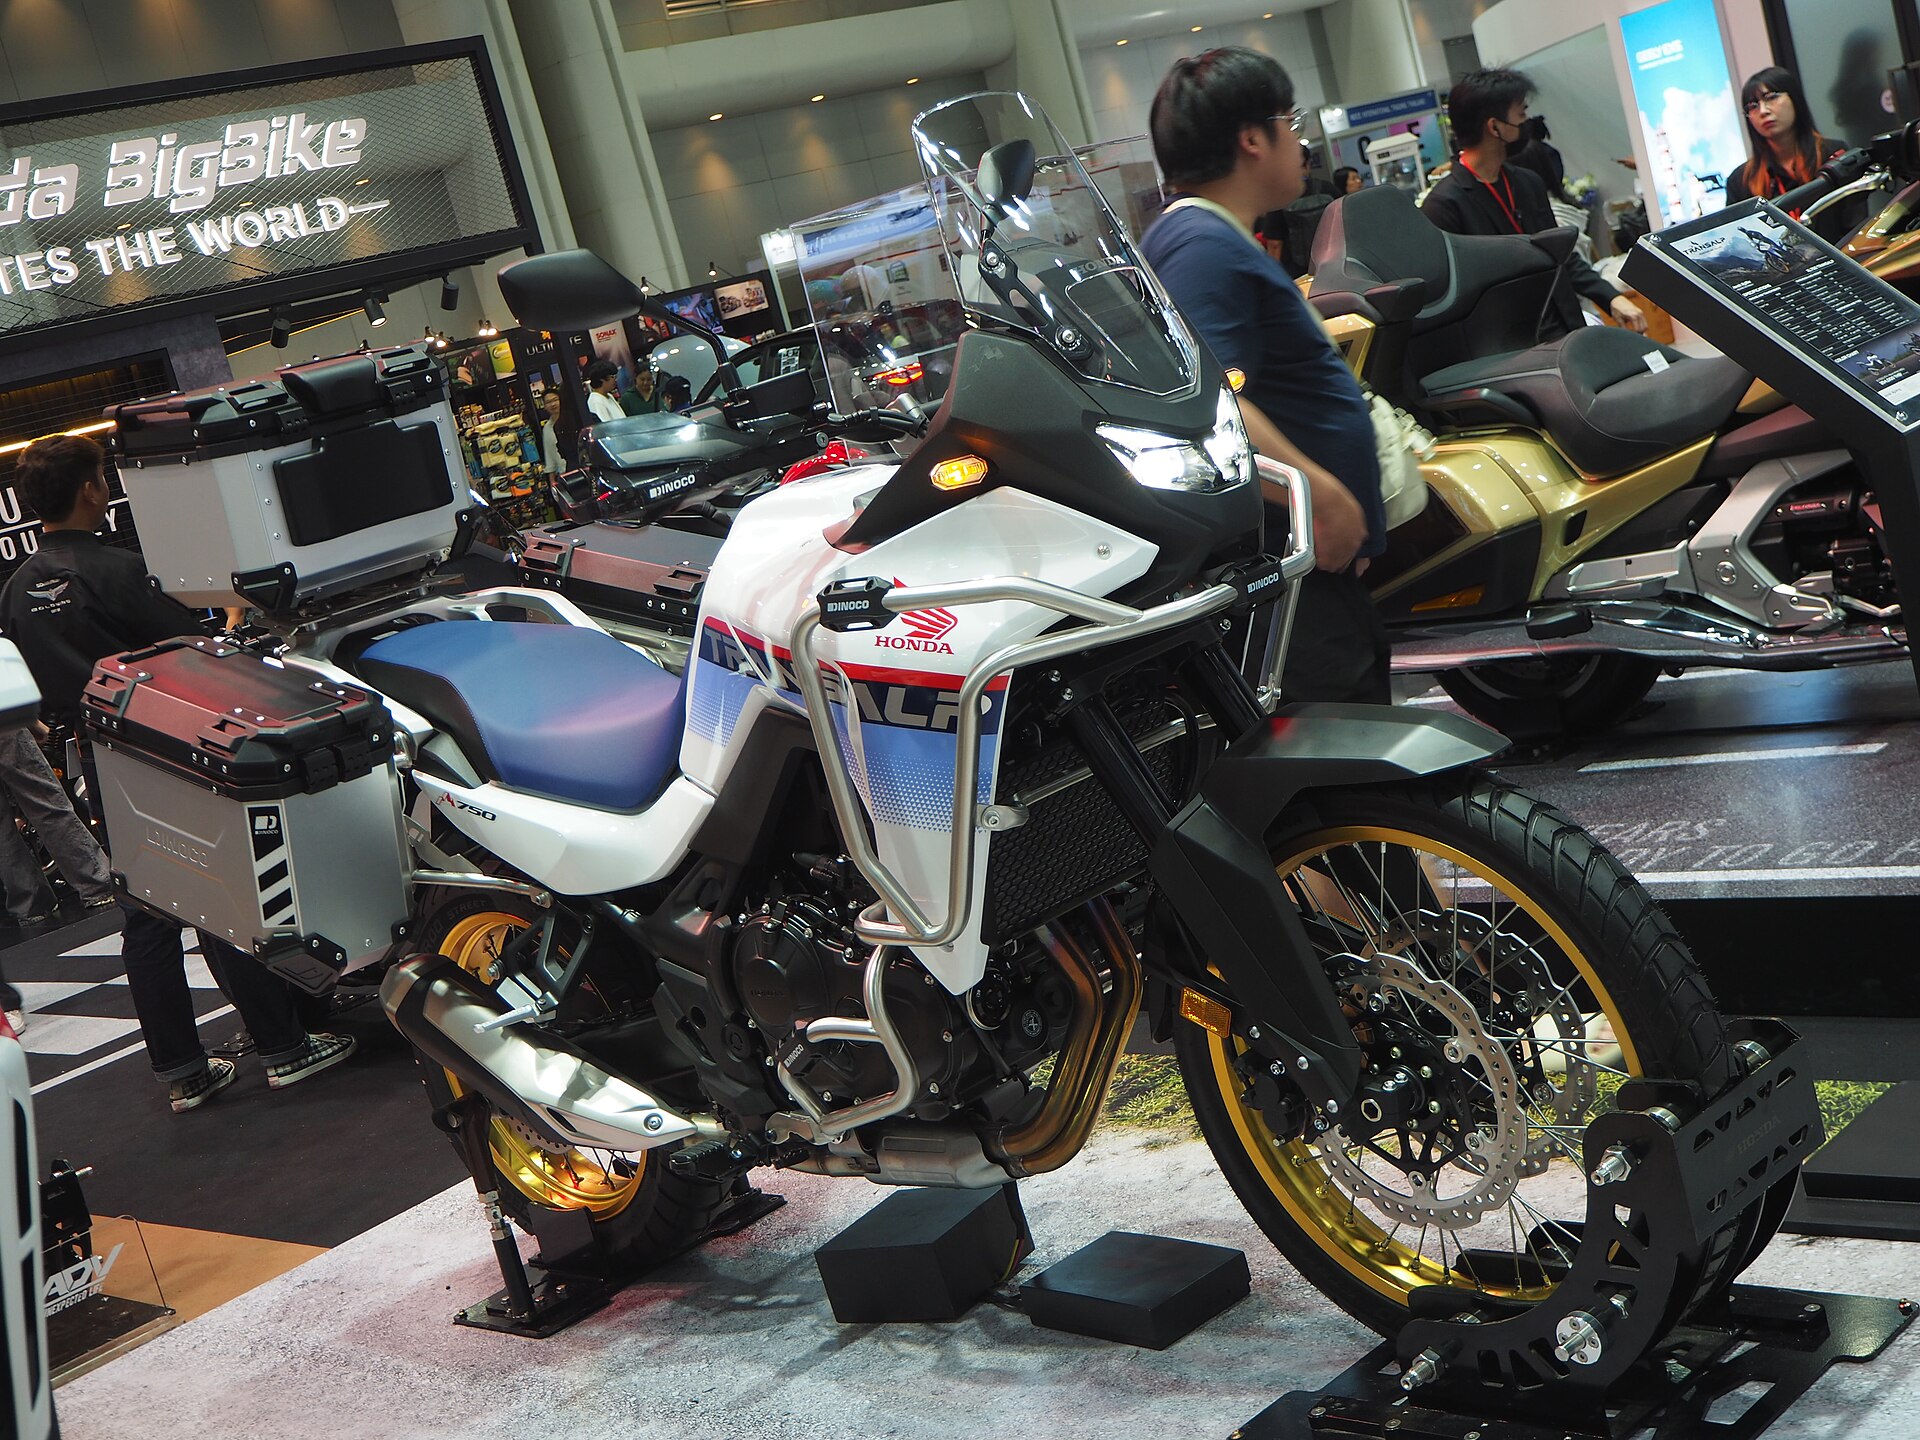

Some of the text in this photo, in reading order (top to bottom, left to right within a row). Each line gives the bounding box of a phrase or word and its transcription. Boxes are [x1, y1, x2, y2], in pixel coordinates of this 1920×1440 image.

[104, 113, 367, 213] BigBike
[86, 227, 182, 276] THE
[186, 197, 349, 257] WORLD
[1683, 237, 1726, 256] TRANSALP
[596, 328, 617, 338] SONAX
[526, 335, 583, 356] ULTITE
[649, 475, 696, 499] DINOCO
[1247, 572, 1279, 594] DINOCO
[827, 599, 870, 612] DINOCO
[874, 635, 955, 655] HONDA
[783, 1043, 805, 1068] DINOCO
[1737, 1115, 1782, 1155] HONDA
